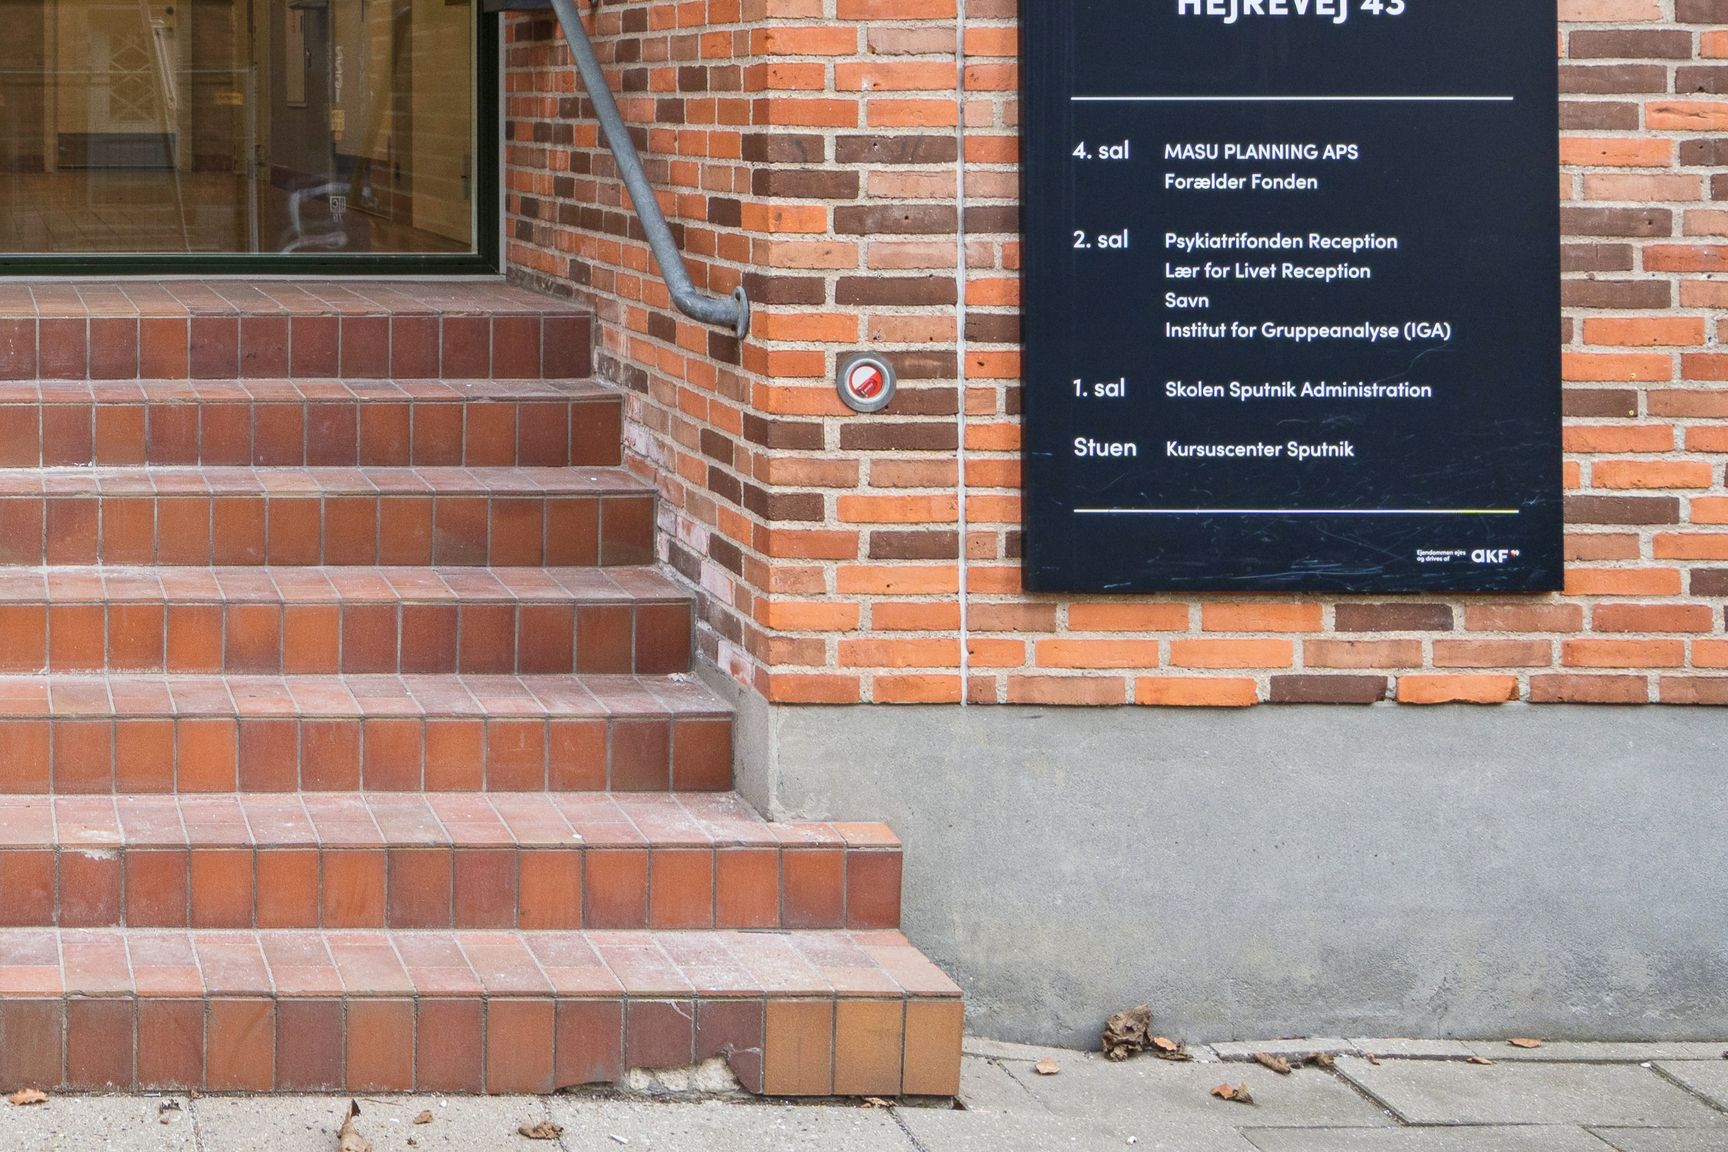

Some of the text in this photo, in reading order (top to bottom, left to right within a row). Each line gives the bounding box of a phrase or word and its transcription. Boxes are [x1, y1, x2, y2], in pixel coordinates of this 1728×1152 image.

[1071, 139, 1129, 160] 4. sal
[1164, 143, 1359, 161] MASU PLANNING APS
[1164, 172, 1318, 190] Forælder Fonden
[1073, 228, 1129, 249] 2. sal
[1165, 231, 1398, 254] Psykiatrifonden Reception
[1165, 261, 1371, 283] Lær for Livet Reception
[1164, 291, 1210, 309] Savn
[1165, 320, 1452, 343] Institut for Gruppeanalyse (IGA)
[1072, 377, 1125, 398] 1. sal
[1165, 380, 1432, 402] Skolen Sputnik Administration
[1073, 436, 1137, 457] Stuen
[1166, 440, 1355, 462] Kursuscenter Sputnik
